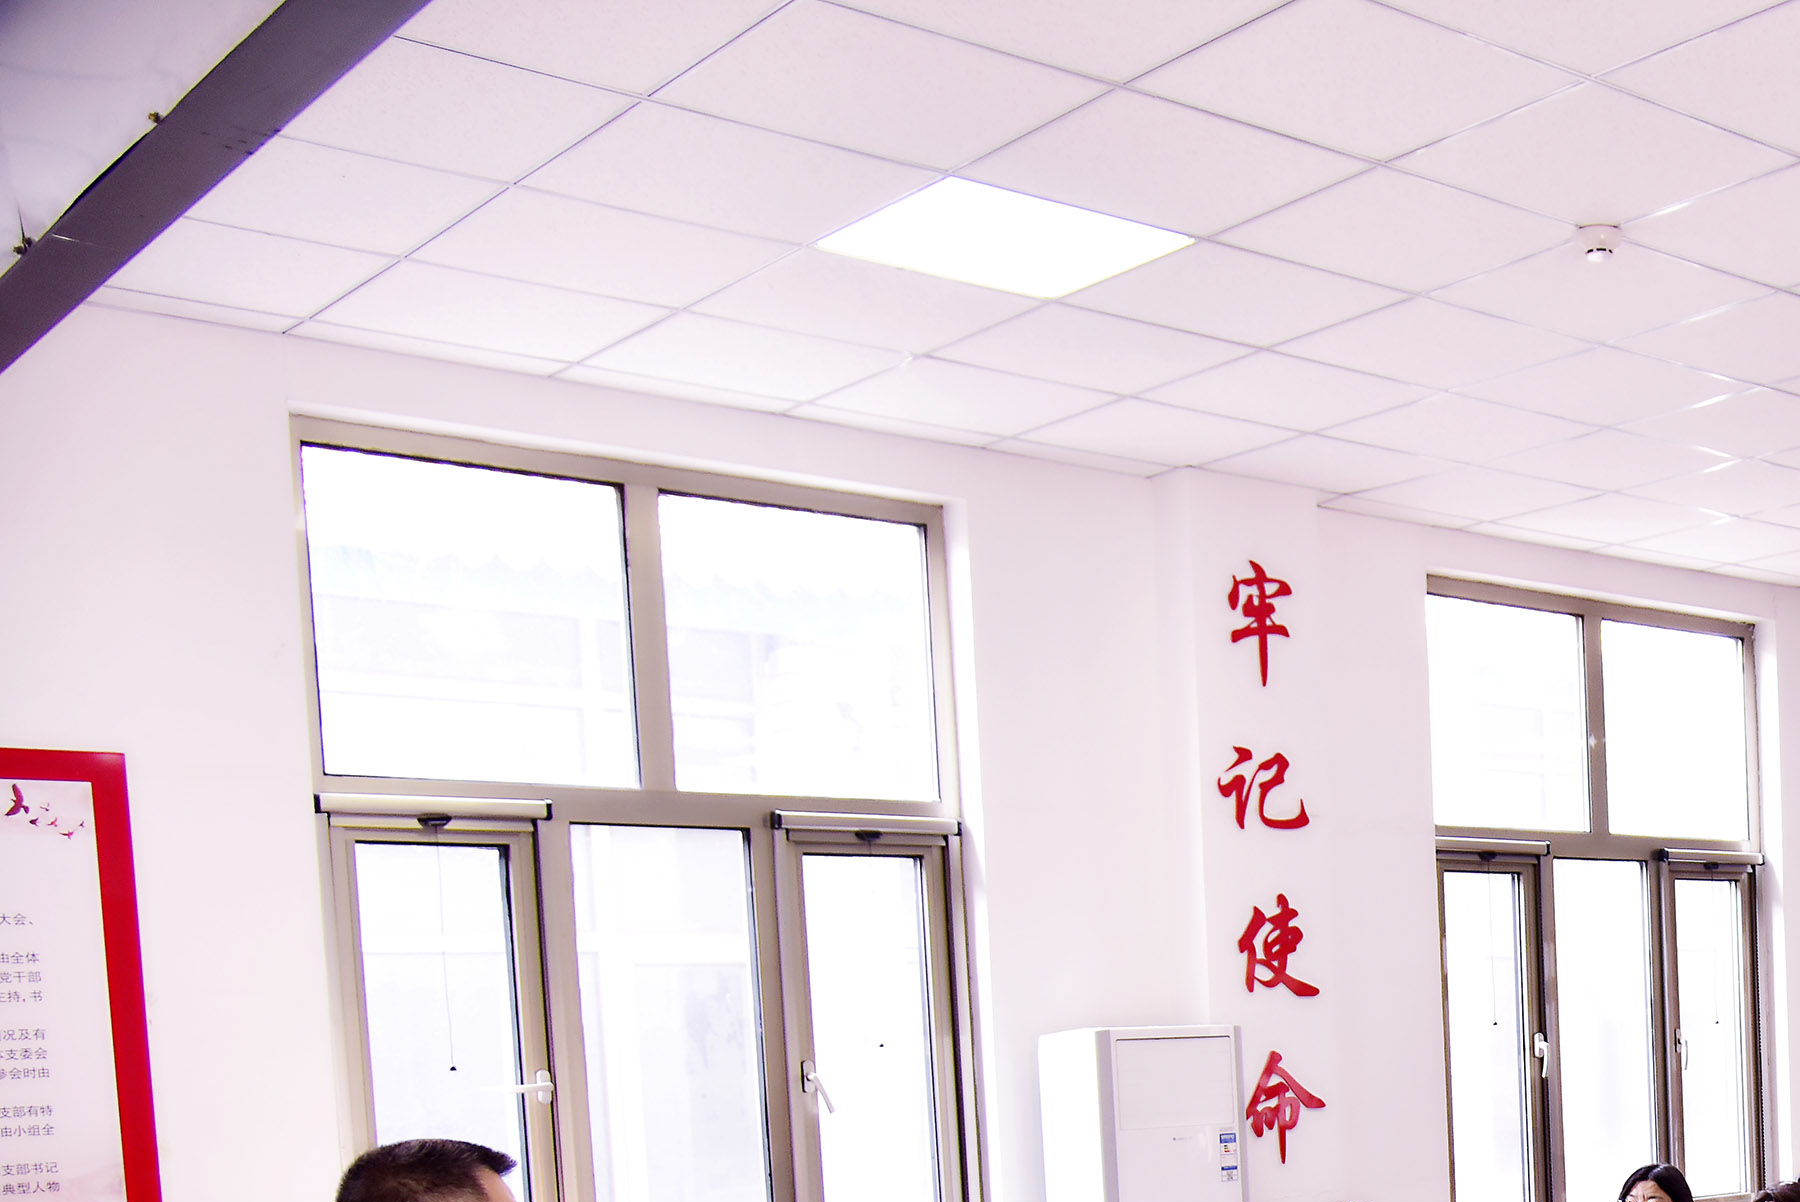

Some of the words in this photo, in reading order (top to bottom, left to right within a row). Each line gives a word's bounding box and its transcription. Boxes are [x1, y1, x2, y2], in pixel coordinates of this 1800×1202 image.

[1217, 560, 1326, 1164] 牢记使命
[0, 1028, 46, 1041] 况及有
[0, 1104, 53, 1119] 支部有特
[1, 1123, 55, 1138] 由小组全
[2, 1161, 59, 1177] 支部书记
[2, 1180, 61, 1196] 典型人物
